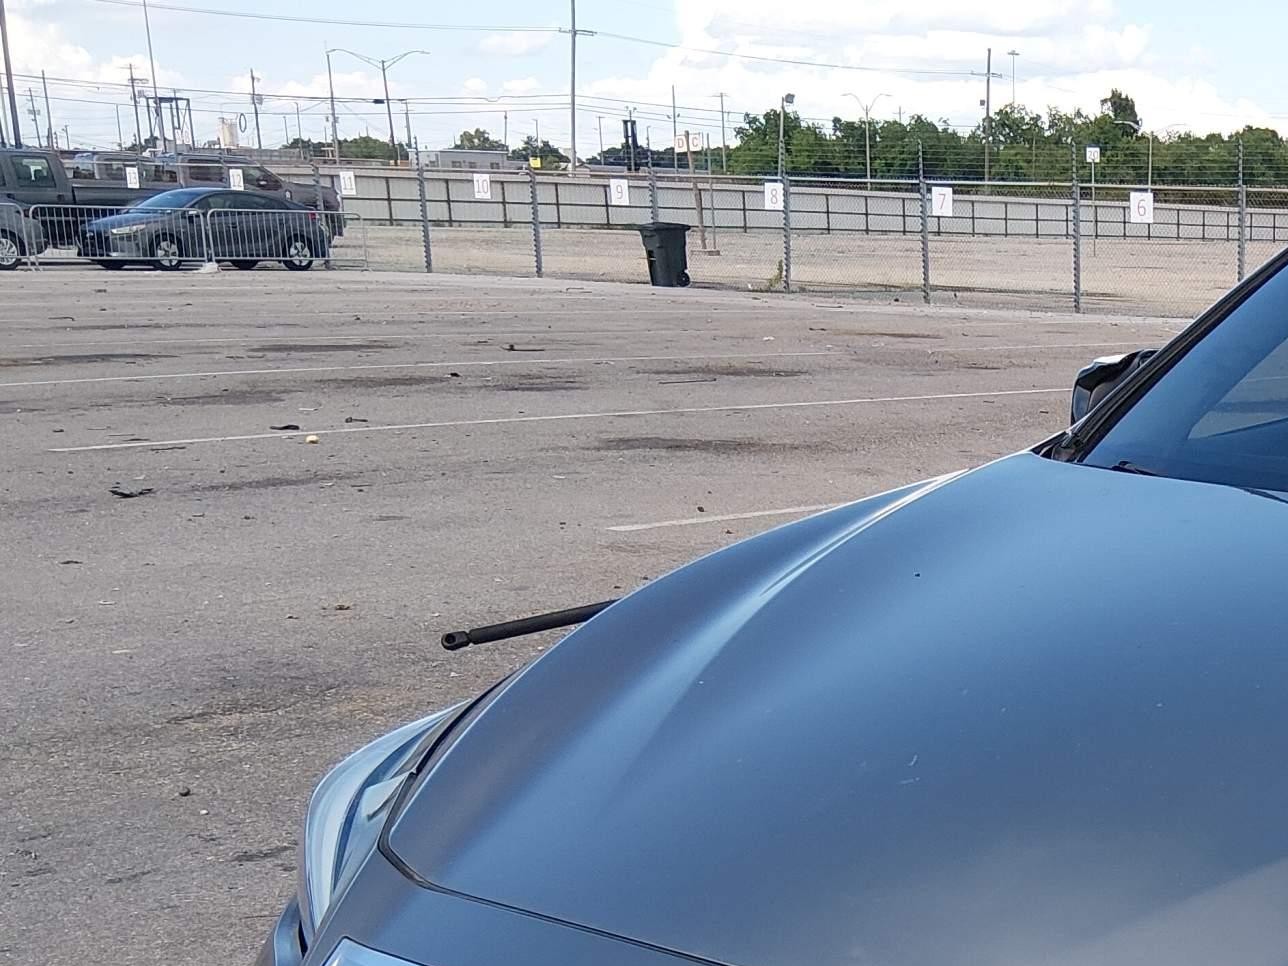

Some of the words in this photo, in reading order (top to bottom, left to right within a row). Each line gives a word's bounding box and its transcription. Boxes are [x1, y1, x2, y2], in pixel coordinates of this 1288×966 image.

[677, 137, 684, 149] D
[691, 136, 699, 147] C
[232, 173, 242, 187] 12
[343, 176, 353, 191] 11
[476, 179, 489, 194] 10
[616, 186, 624, 200] 9
[770, 188, 778, 205] 8
[938, 193, 946, 209] 7
[1137, 199, 1146, 216] 6
